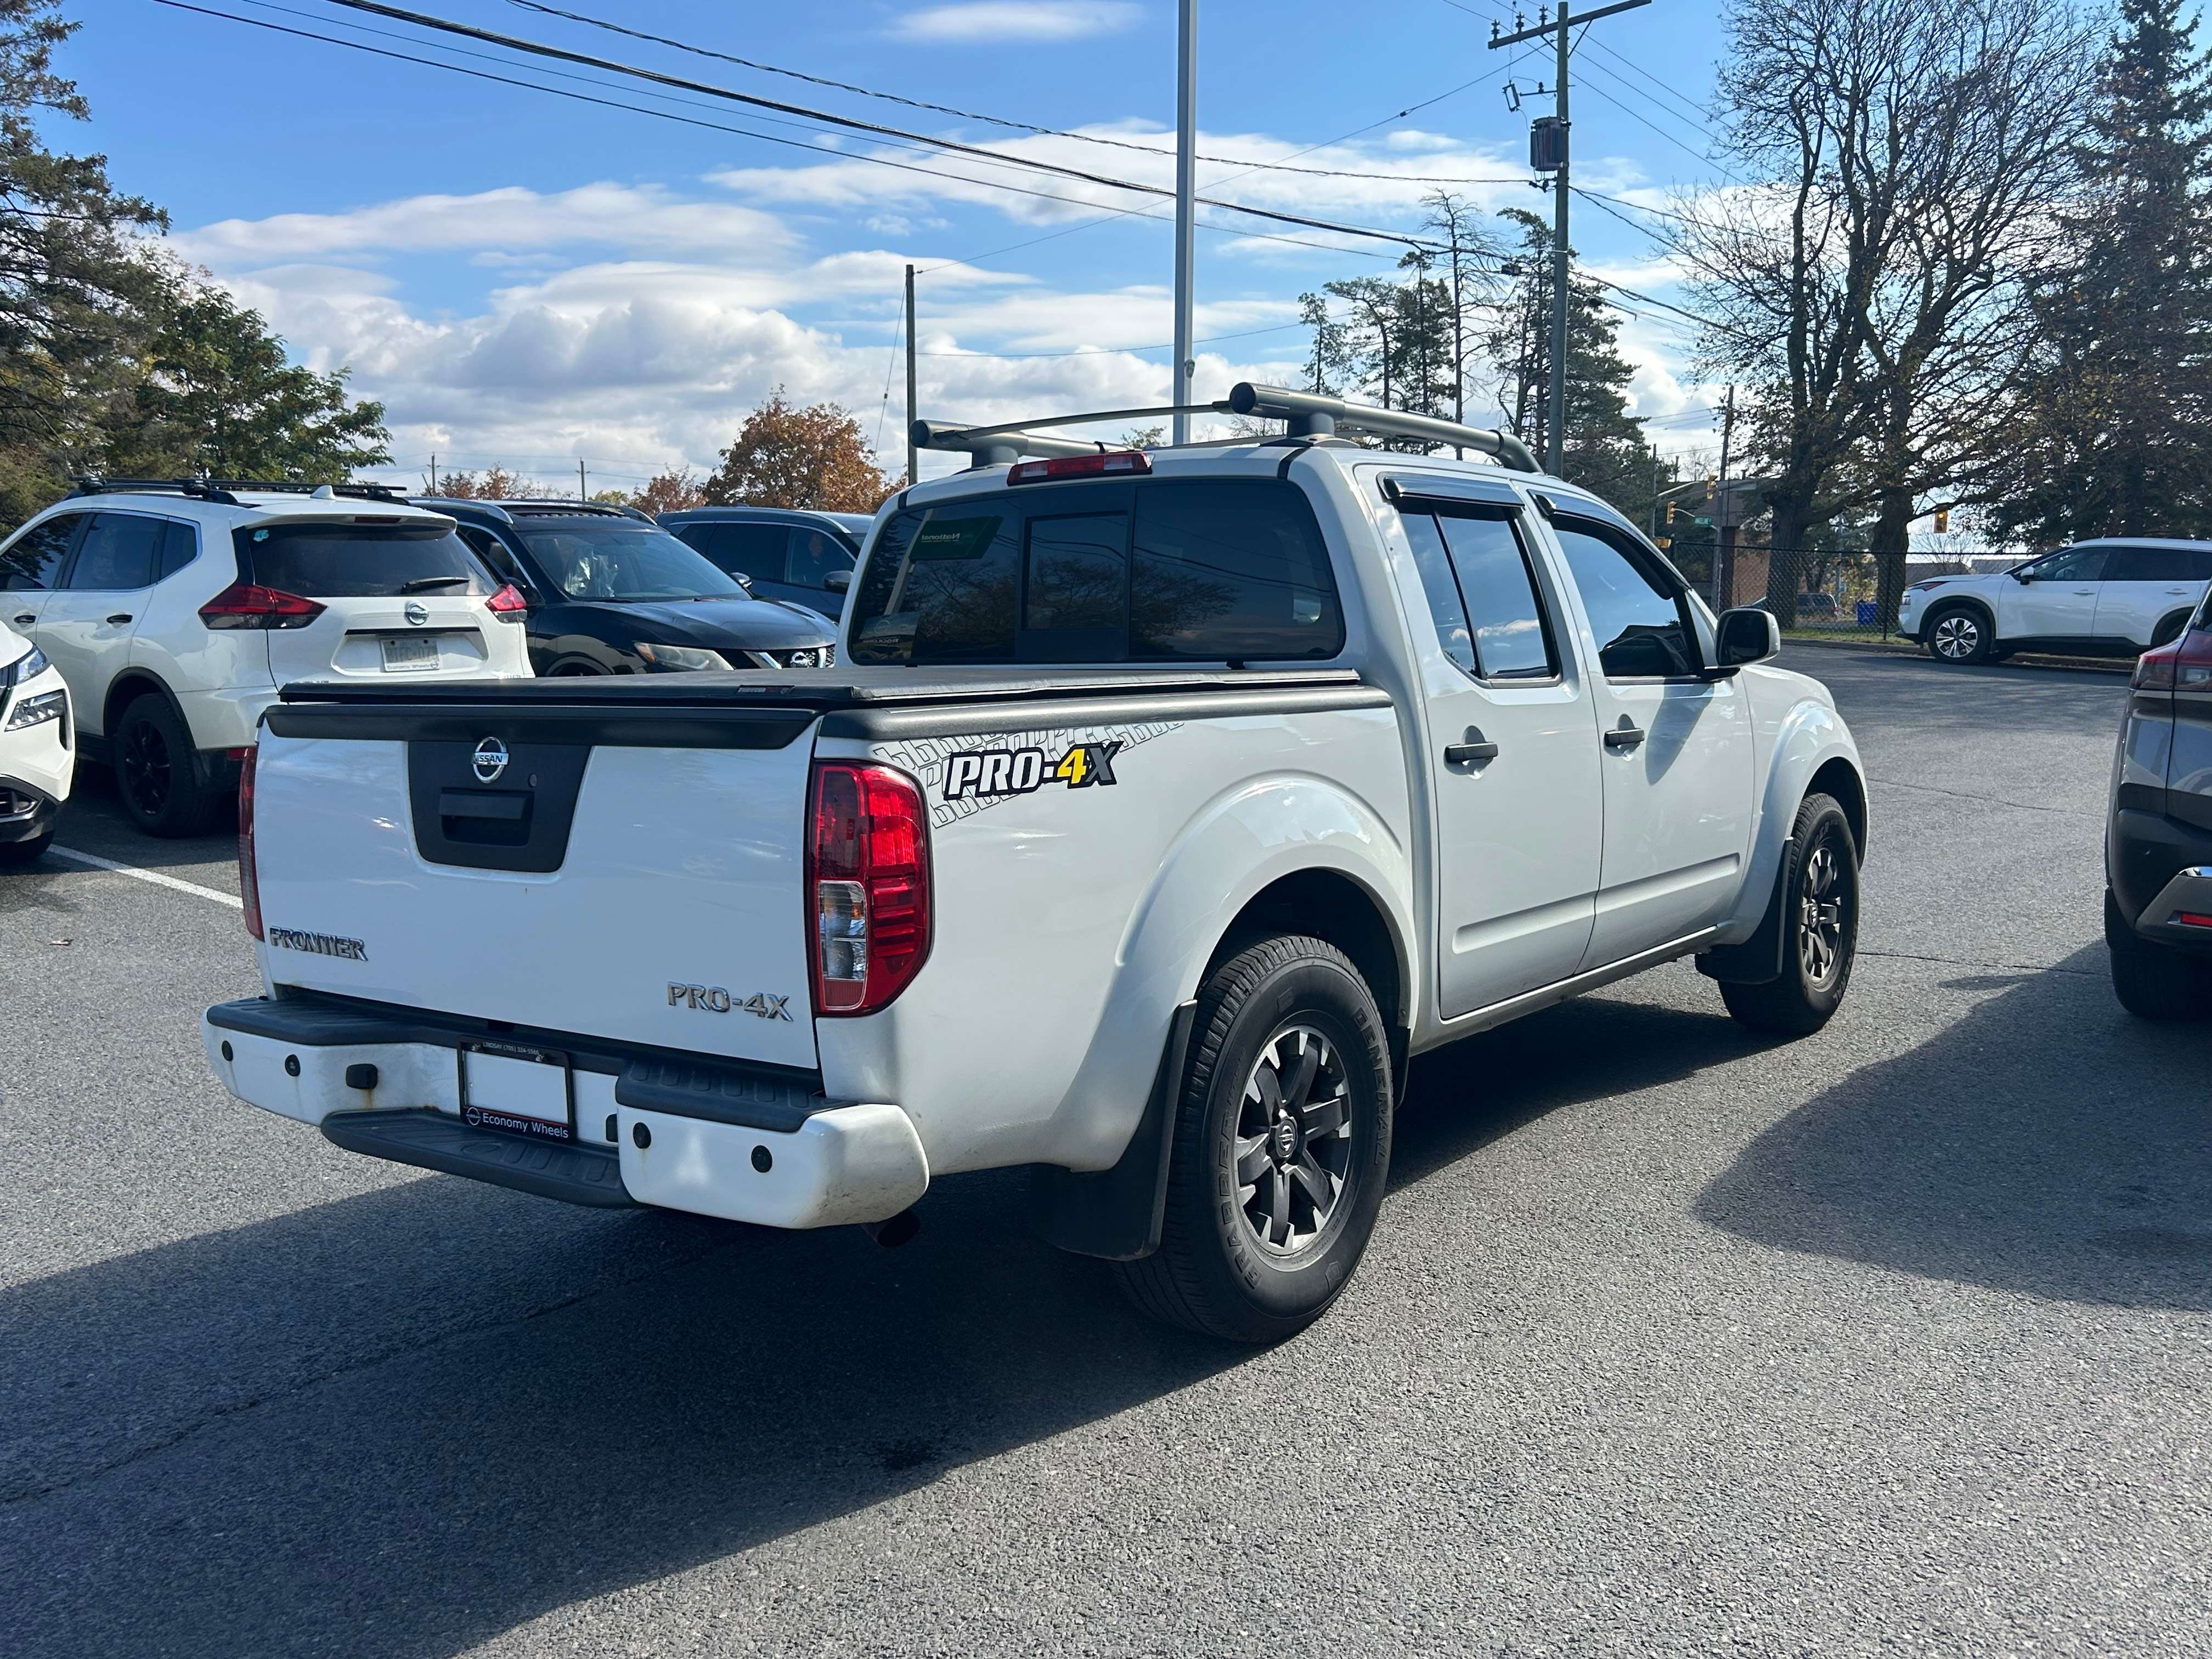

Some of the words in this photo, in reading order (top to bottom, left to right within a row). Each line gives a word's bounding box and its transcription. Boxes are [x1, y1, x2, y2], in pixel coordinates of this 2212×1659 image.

[944, 742, 1123, 800] PRO-4X
[269, 926, 368, 961] FRONTIER
[667, 981, 794, 1022] PRO-4X
[483, 1113, 528, 1132] Economy
[532, 1121, 569, 1138] Wheels
[1219, 1109, 1262, 1289] GRABBER
